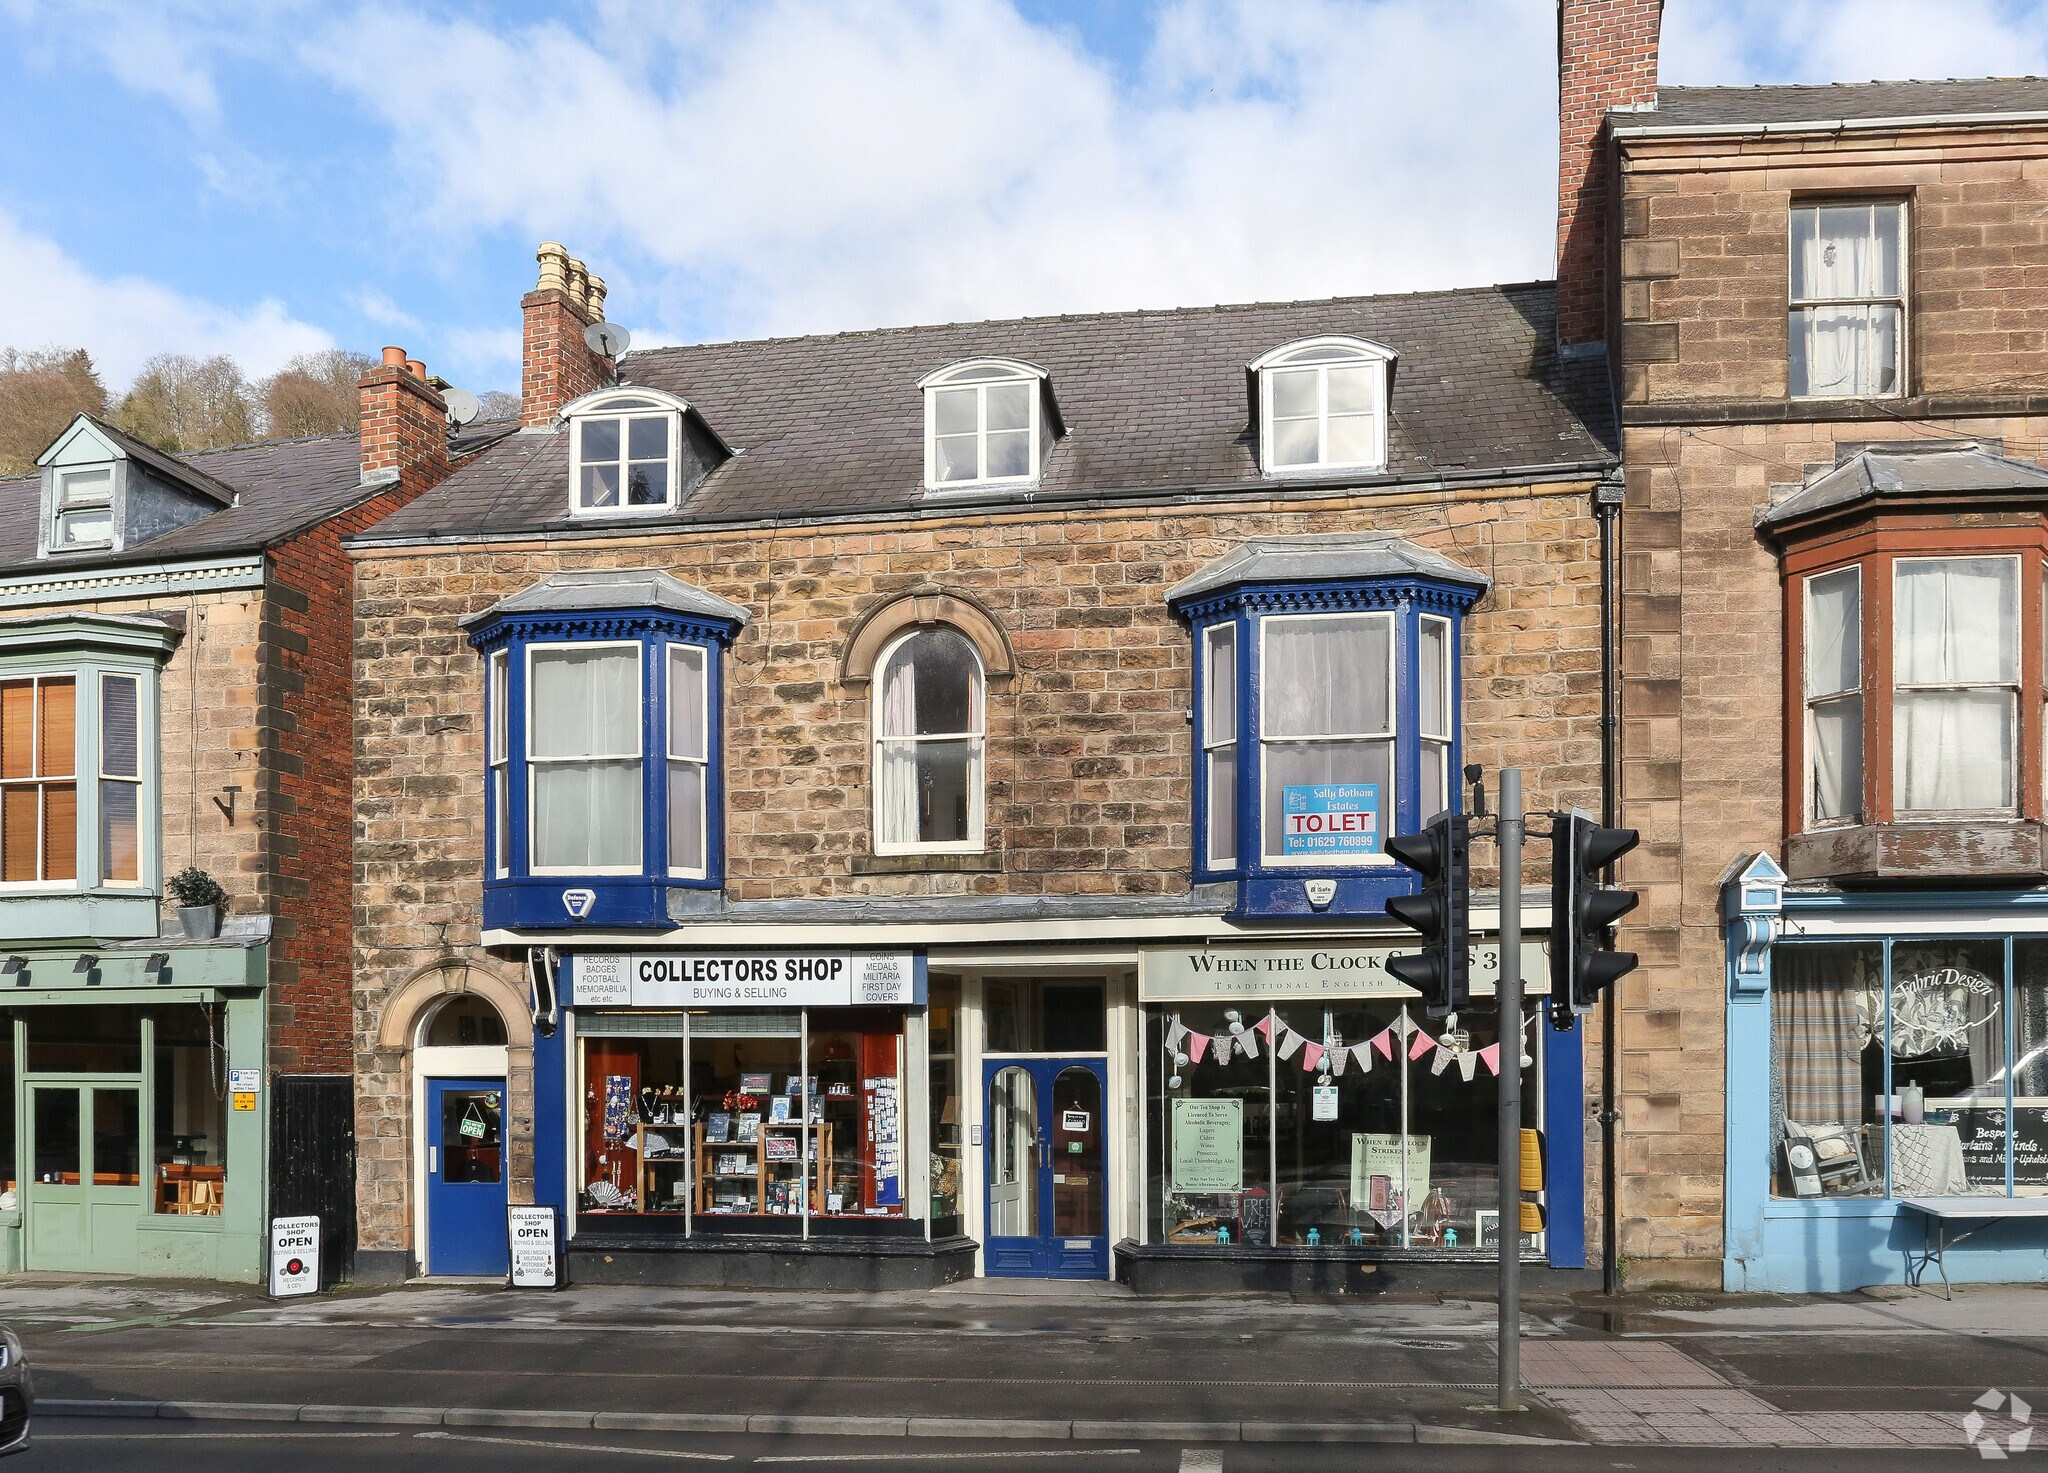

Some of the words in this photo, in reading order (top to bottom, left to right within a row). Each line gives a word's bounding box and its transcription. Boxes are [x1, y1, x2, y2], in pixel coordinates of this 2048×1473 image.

[1314, 788, 1336, 800] Sally
[1338, 788, 1373, 798] Botham
[1328, 802, 1359, 811] Estates
[1292, 815, 1322, 832] TO
[1329, 813, 1369, 831] LET
[1289, 838, 1304, 847] Tel:
[1308, 837, 1335, 847] 01629
[1338, 836, 1373, 846] 760899
[870, 952, 894, 960] COINS
[1483, 952, 1498, 969] 3
[639, 959, 778, 982] COLLECTORS
[784, 958, 842, 981] SHOP
[1894, 970, 1942, 998] Fabric
[1941, 968, 1993, 996] Design
[693, 988, 731, 998] BUYING
[734, 988, 741, 998] &
[744, 987, 787, 998] SELLING
[866, 993, 898, 1001] COVERS
[463, 1125, 482, 1136] OPEN
[1976, 1127, 2019, 1140] Bespoe
[1960, 1140, 1993, 1150] urtains
[1979, 1154, 1993, 1163] and
[1244, 1199, 1270, 1216] FREE
[518, 1229, 548, 1237] OPEN
[278, 1237, 312, 1247] OPEN
